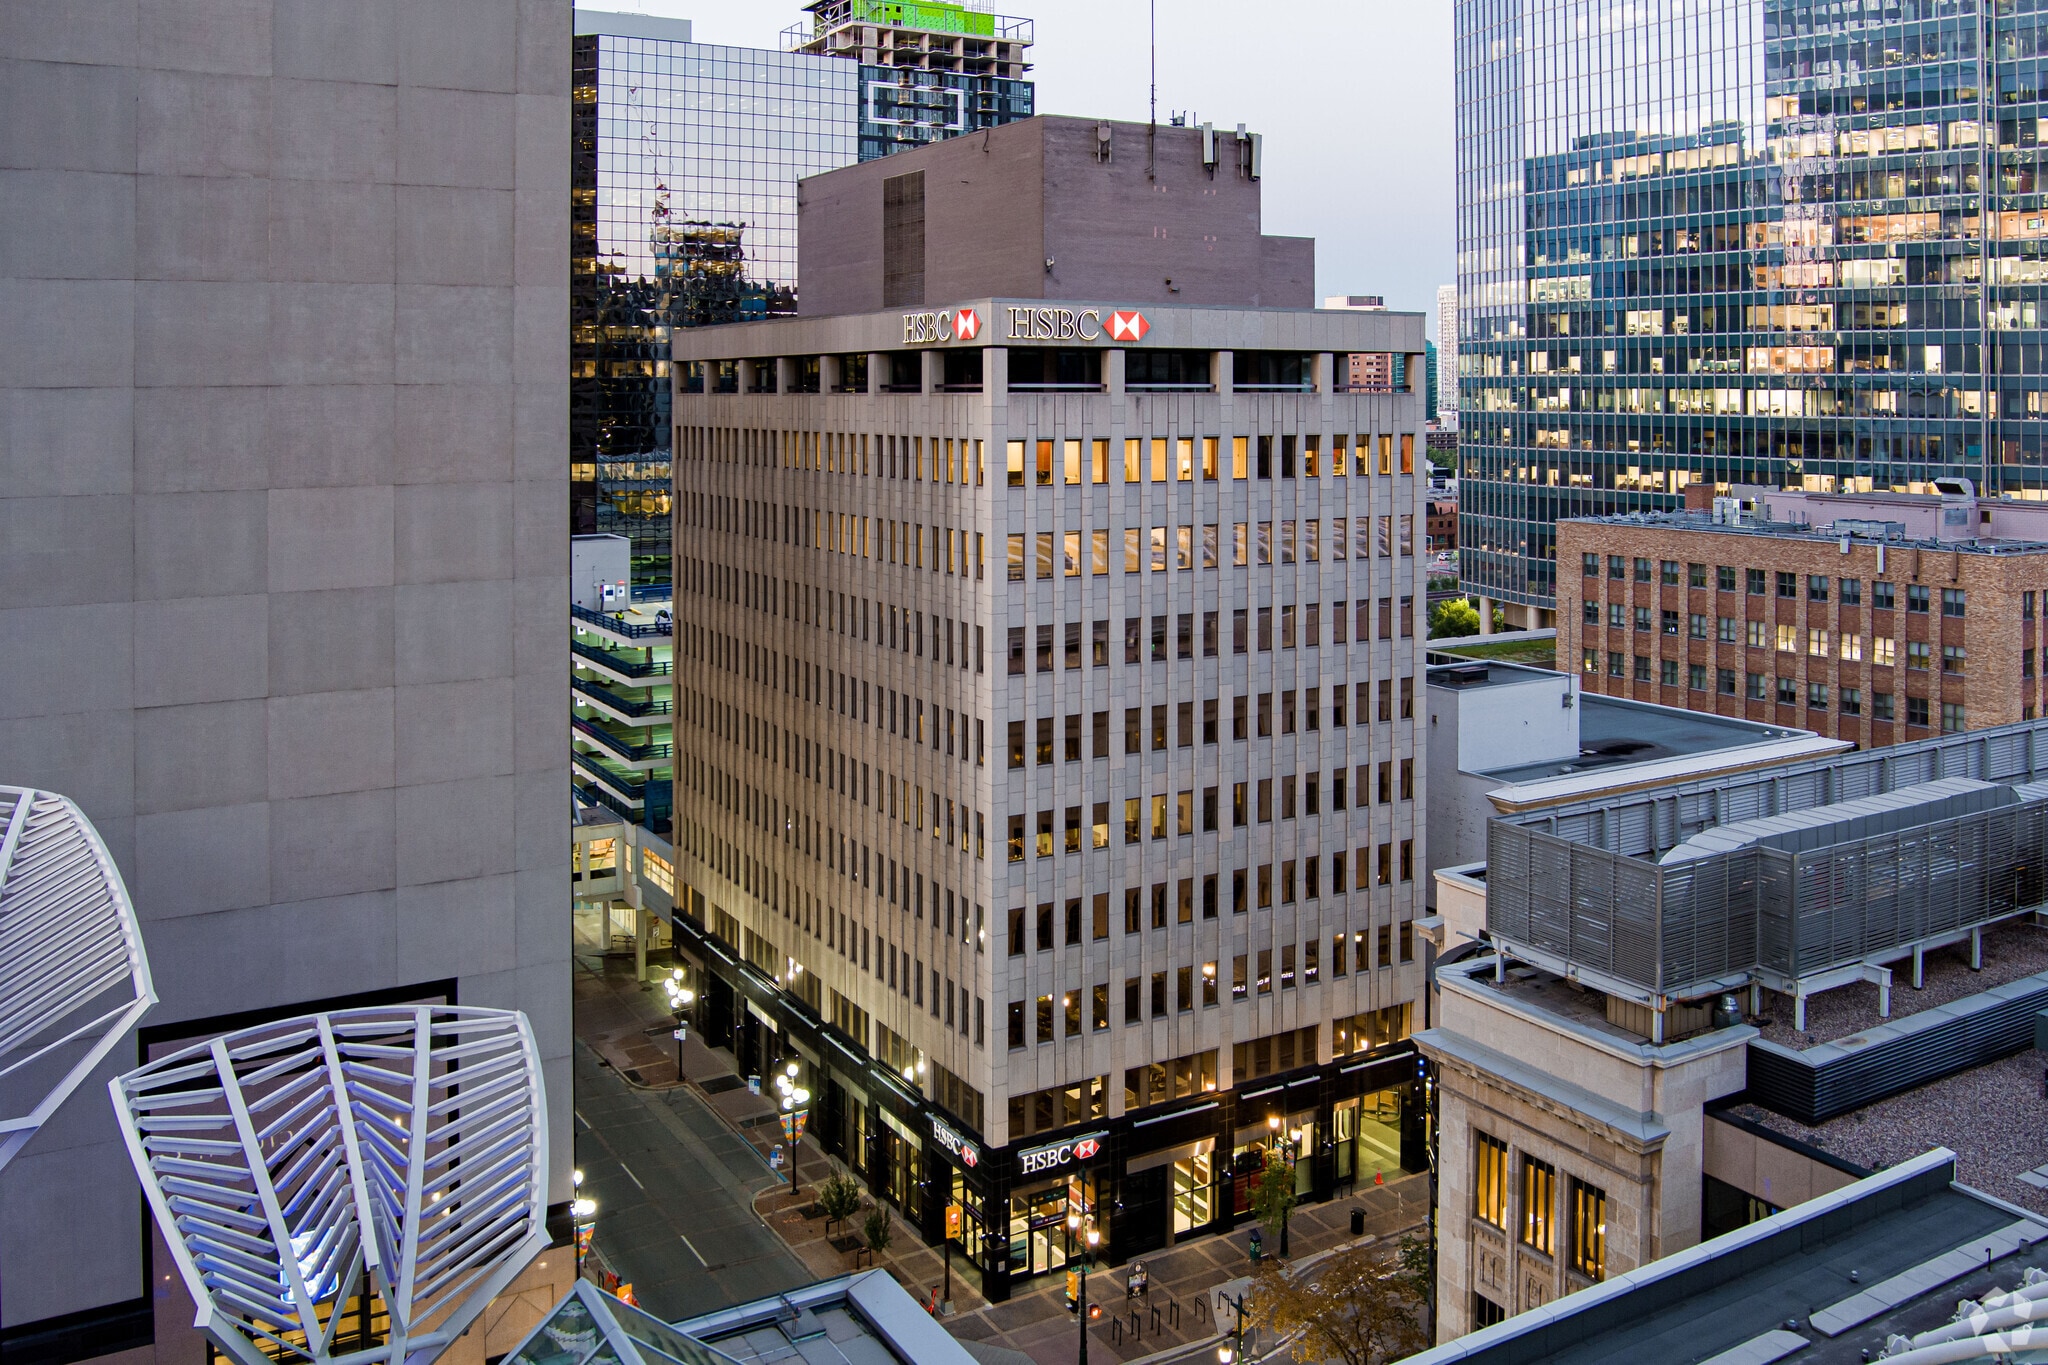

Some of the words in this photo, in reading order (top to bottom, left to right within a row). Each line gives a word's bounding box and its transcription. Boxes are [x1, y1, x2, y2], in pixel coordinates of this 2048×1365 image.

[903, 310, 952, 343] HSBC
[1007, 307, 1100, 341] HSBC
[932, 1121, 962, 1156] HSBC
[1021, 1145, 1072, 1175] HSBC
